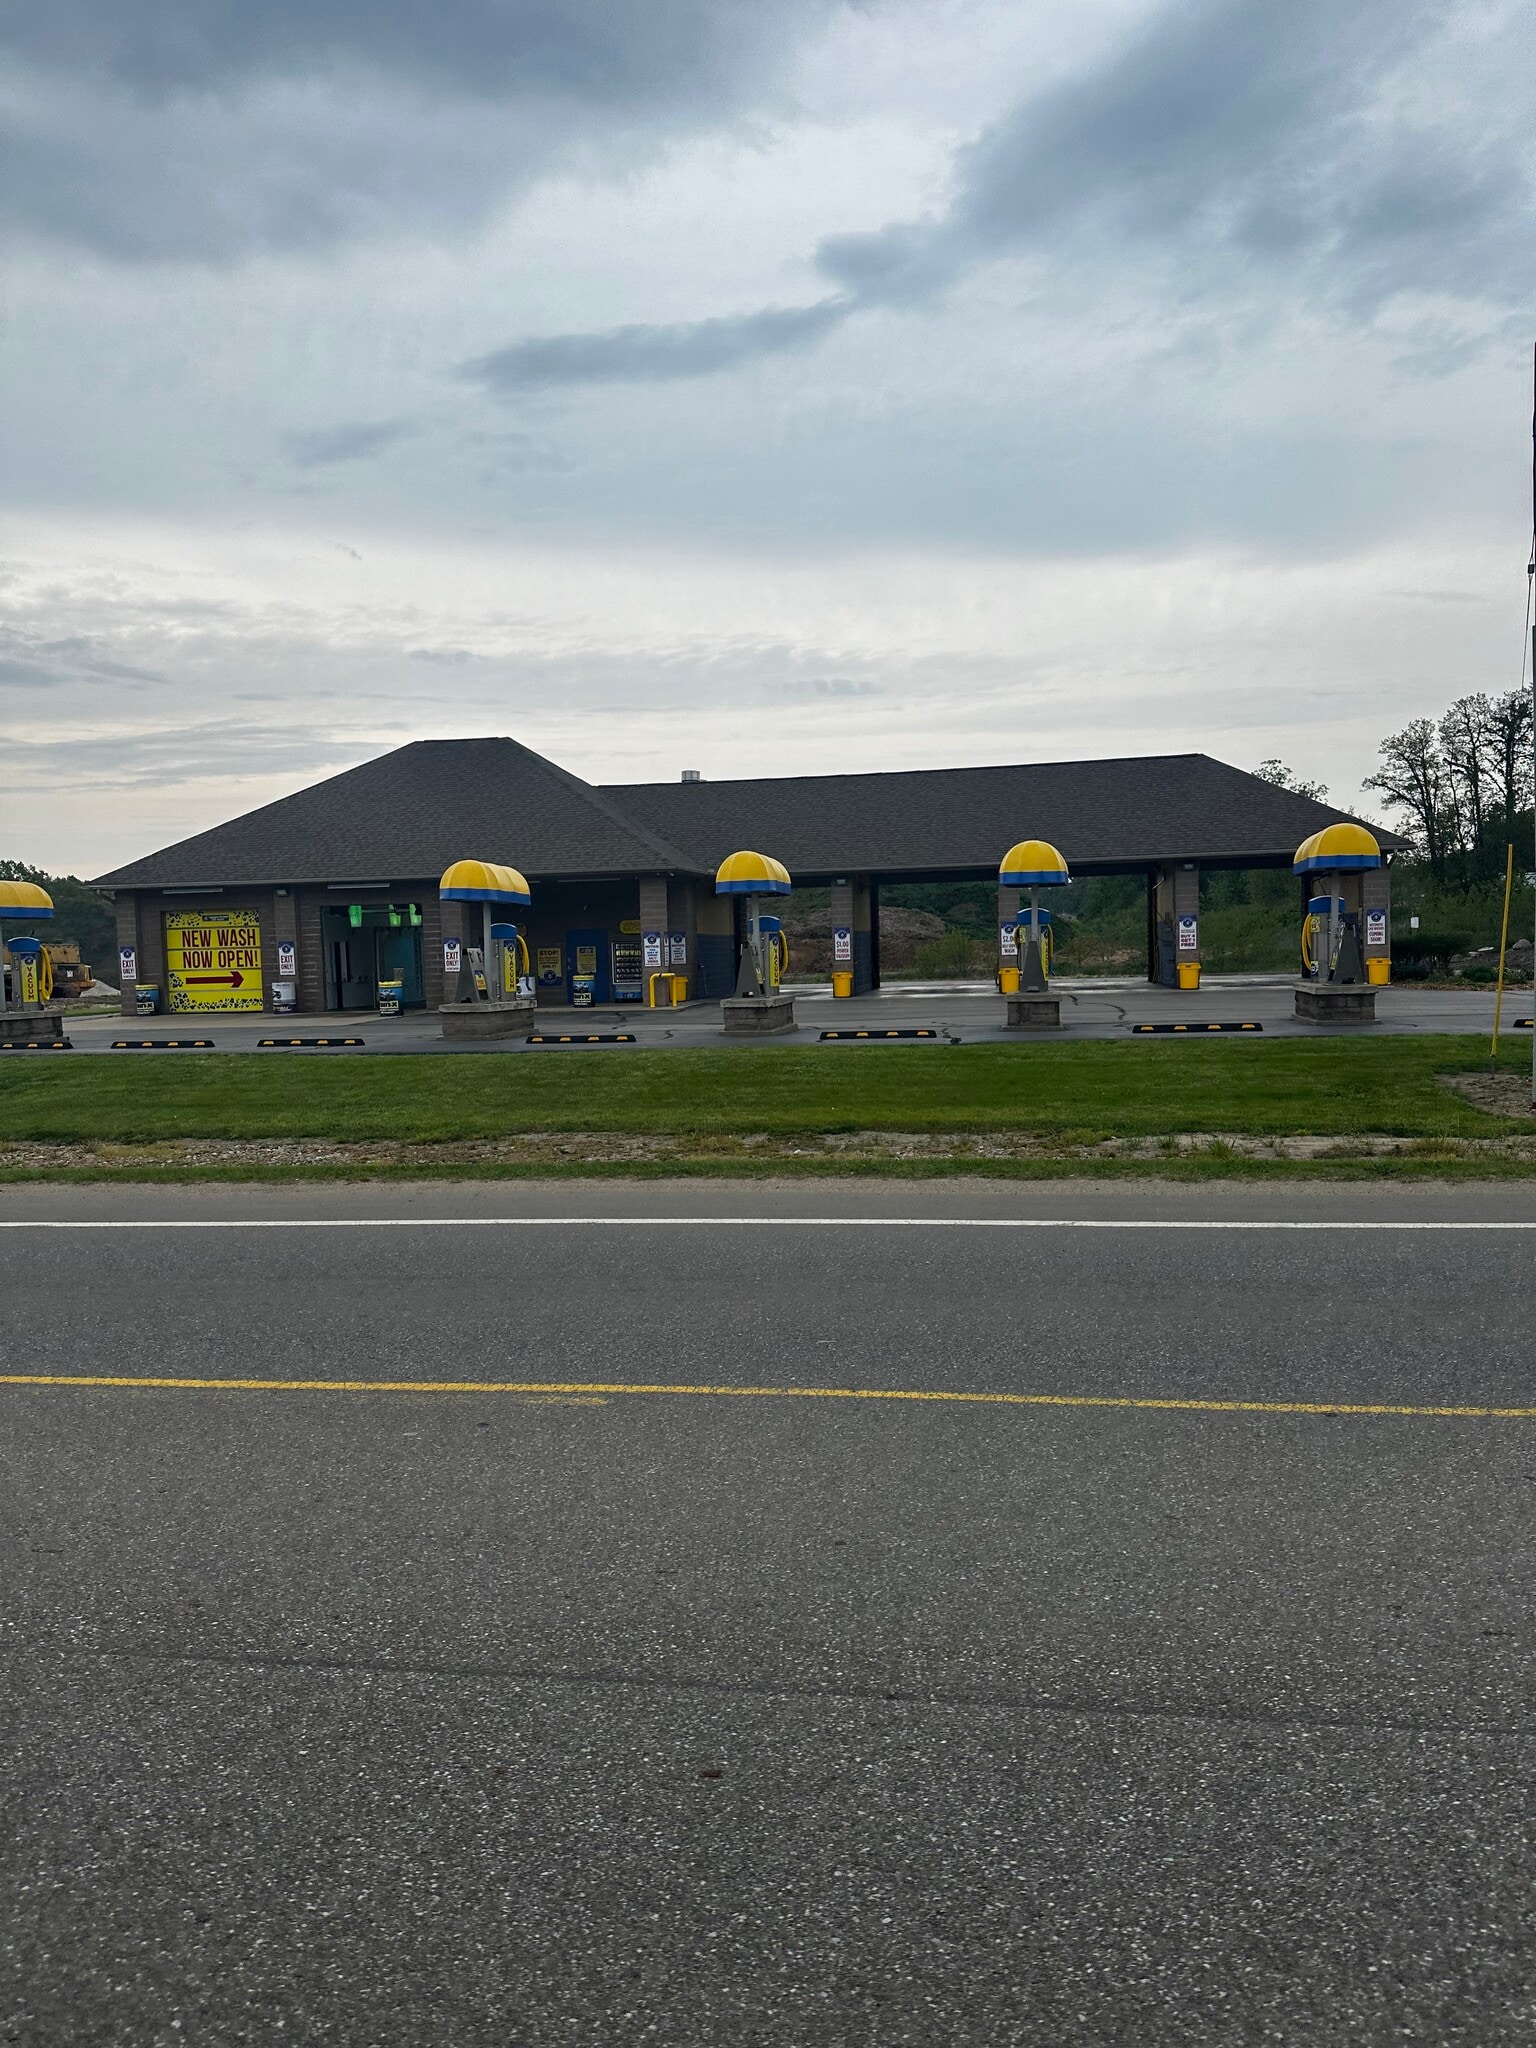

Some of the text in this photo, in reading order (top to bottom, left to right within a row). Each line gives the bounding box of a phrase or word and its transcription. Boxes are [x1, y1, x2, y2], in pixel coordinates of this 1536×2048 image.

[182, 928, 256, 948] NEW WASH
[183, 950, 258, 968] NOW OPEN!
[281, 955, 293, 963] EXIT
[446, 952, 458, 960] EXIT
[26, 966, 34, 1000] VACUUM
